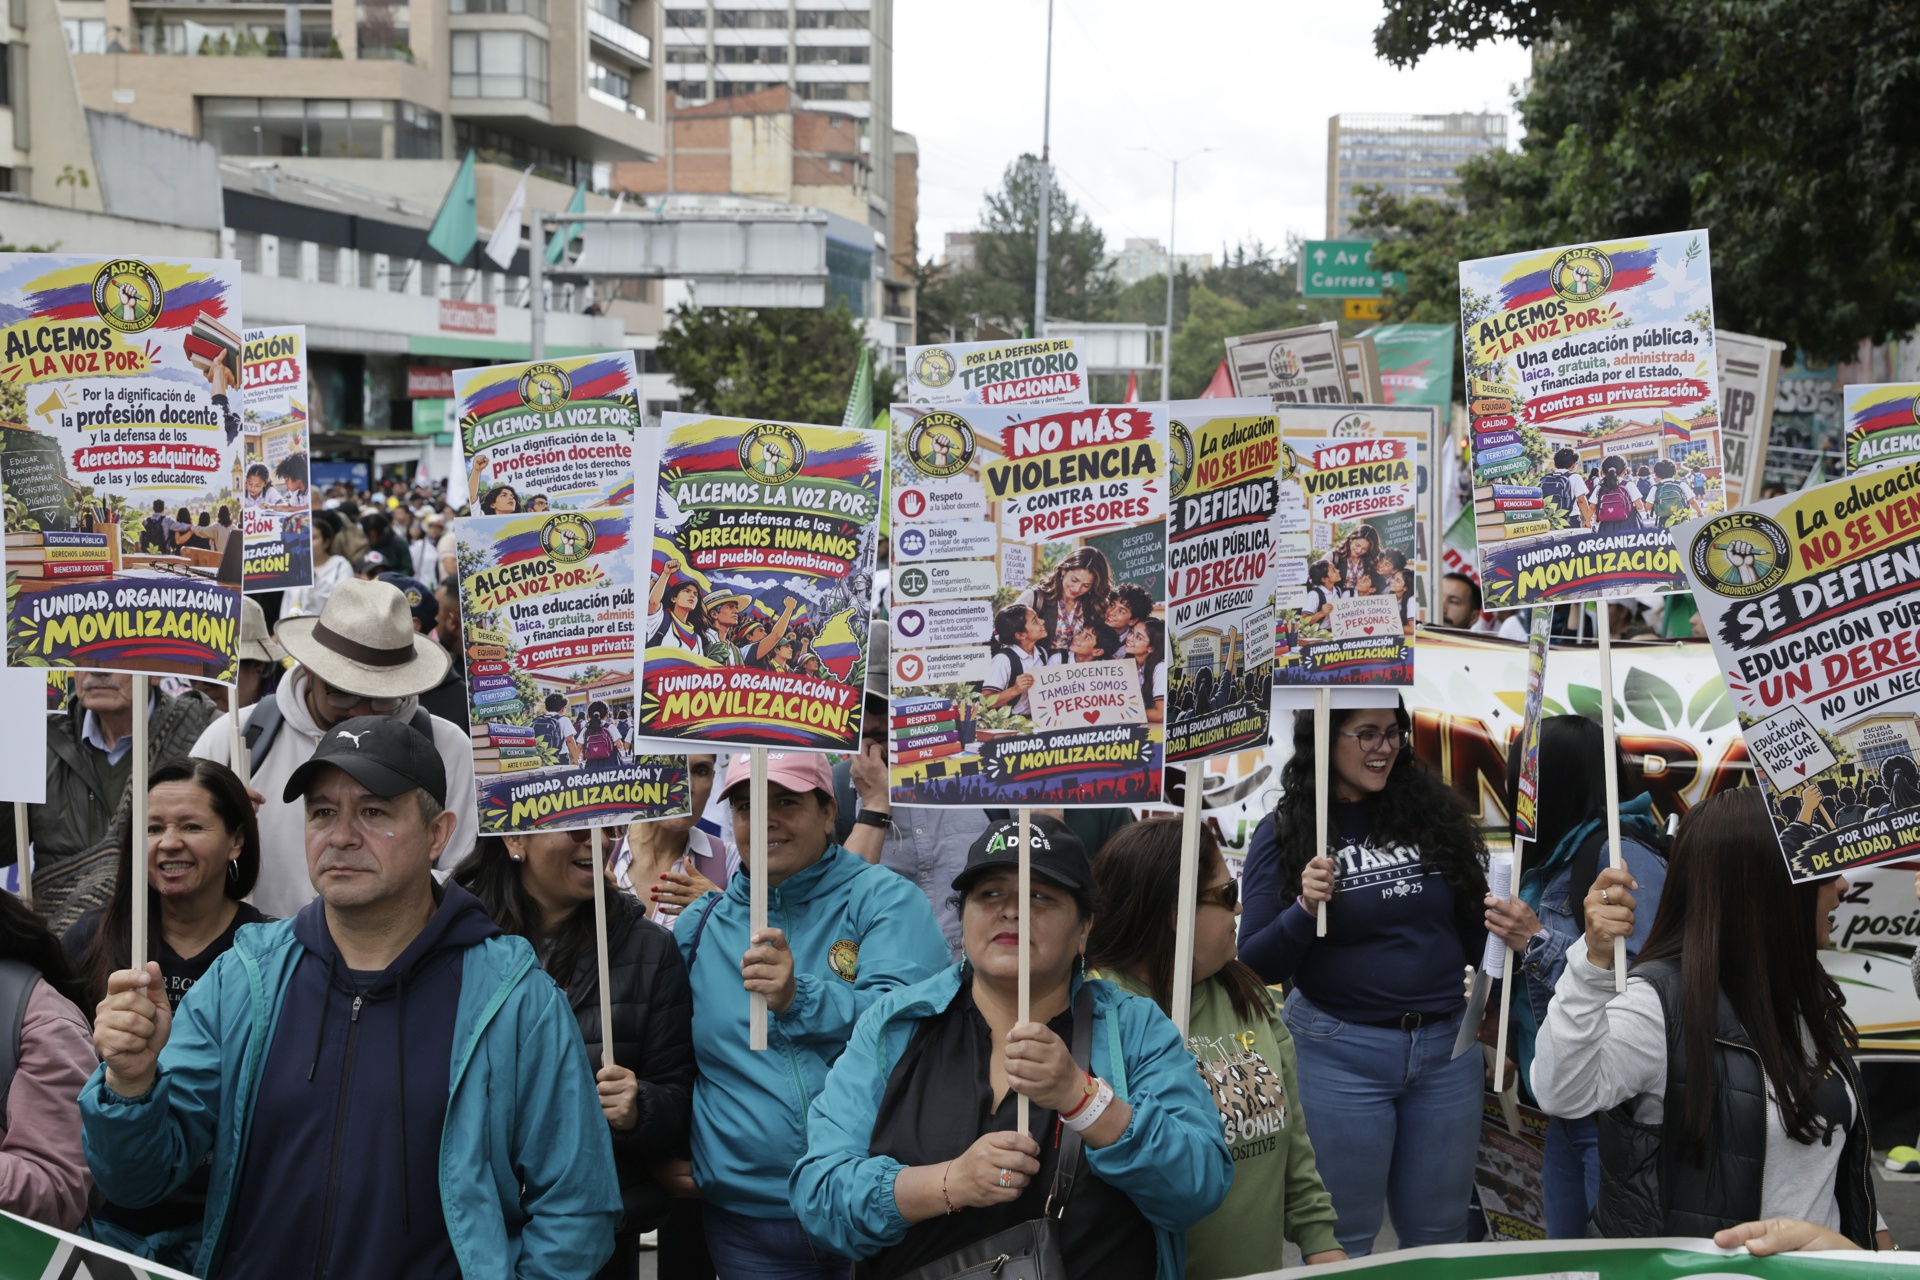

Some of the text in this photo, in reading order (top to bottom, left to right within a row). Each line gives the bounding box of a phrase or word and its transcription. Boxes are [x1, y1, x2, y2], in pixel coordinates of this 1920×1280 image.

[109, 262, 145, 278] ADEC
[1334, 250, 1358, 265] Av
[1563, 248, 1594, 263] ADEC
[1312, 272, 1375, 287] Carrera
[244, 330, 265, 342] UNA
[1479, 300, 1568, 347] ALCEMOS
[1499, 307, 1608, 355] LA VOZ POR:
[4, 327, 112, 362] ALCEMOS
[924, 348, 945, 359] ADEC
[966, 340, 1069, 367] POR LA DEFENSA DEL
[1515, 328, 1700, 370] Una educación pública,
[29, 348, 146, 378] LA VOZ POR:
[959, 352, 1078, 391] TERRITORIO
[1520, 350, 1696, 384] laica, gratuita, administrada
[82, 388, 196, 406] Por la dignificación de
[987, 375, 1078, 405] NACIONAL
[1482, 384, 1511, 398] DERECHO
[1528, 384, 1704, 420] y contra su privatización.
[61, 405, 219, 432] la profesión docente
[925, 411, 959, 428] ADEC
[1480, 402, 1507, 412] EQUIDAD
[472, 407, 635, 447] ALCEMOS LA VOZ POR:
[757, 425, 790, 439] ADEC
[1013, 408, 1134, 457] NO MÁS
[1199, 416, 1275, 460] La educación
[1481, 417, 1509, 430] CALIDAD
[9, 455, 40, 467] EDUCAR
[79, 446, 218, 472] derechos adquiridos
[492, 443, 632, 479] profesión docente
[1196, 435, 1279, 491] NO SE VENDE
[1320, 440, 1394, 470] NO MÁS
[5, 463, 56, 478] TRANSFORMAR
[11, 473, 54, 486] ACOMPAÑAR
[986, 443, 1157, 498] VIOLENCIA
[1304, 461, 1409, 494] VIOLENCIA
[17, 483, 60, 496] CONSTRUIR
[25, 494, 62, 507] DIGNIDAD
[676, 482, 871, 518] ALCEMOS LA VOZ POR:
[929, 491, 963, 503] Respeto
[1026, 481, 1129, 512] CONTRA LOS
[1328, 484, 1392, 503] CONTRA LOS
[1018, 496, 1151, 538] PROFESORES
[1184, 480, 1275, 532] DEFIENDE
[1323, 494, 1405, 519] PROFESORES
[718, 512, 832, 533] La defensa de los
[928, 527, 958, 539] Diálogo
[1709, 514, 1753, 539] ADEC
[1794, 509, 1829, 539] La
[49, 533, 104, 547] EDUCACIÓN PÚBLICA
[51, 548, 107, 560] DERECHOS LABORALES
[689, 526, 857, 562] DERECHOS HUMANOS
[1222, 527, 1270, 558] PÚBLICA
[1799, 513, 1877, 572] NO SE
[53, 562, 106, 576] BIENESTAR DOCENTE
[696, 549, 845, 577] del pueblo colombiano
[931, 566, 950, 577] Cero
[1516, 543, 1576, 573] ¡UNIDAD,
[474, 558, 557, 598] ALCEMOS
[493, 568, 592, 605] LA VOZ POR:
[1184, 552, 1267, 600] DERECHO
[1715, 580, 1766, 597] SUBDIRECTIVA
[32, 587, 233, 623] ¡UNIDAD, ORGANIZACIÓN Y
[928, 605, 987, 617] Reconocimiento
[1735, 594, 1787, 638] SE
[45, 612, 237, 658] MOVILIZACIÓN!
[1737, 616, 1873, 684] EDUCACIÓN
[657, 672, 850, 706] ¡UNIDAD, ORGANIZACIÓN Y
[1038, 679, 1129, 700] TAMBIÉN SOMOS
[1040, 665, 1125, 687] LOS DOCENTES
[1758, 664, 1813, 707] UN
[661, 691, 851, 733] MOVILIZACION!
[905, 699, 944, 714] EDUCACIÓN
[905, 713, 937, 726] RESPETO
[1052, 692, 1127, 717] PERSONAS
[907, 734, 949, 749] CONVIVENCIA
[909, 723, 940, 736] DIÁLOGO
[995, 725, 1132, 759] ¡UNIDAD, ORGANIZACIÓN
[1752, 717, 1807, 753] EDUCACIÓN
[1764, 720, 1779, 734] LA
[918, 748, 934, 758] PAZ
[1004, 739, 1141, 774] Y MOVILIZACIÓN!
[1762, 731, 1813, 763] PÚBLICA
[1769, 741, 1821, 774] NOS UNE
[510, 765, 664, 802] ¡UNIDAD, ORGANIZACIÓN Y
[510, 781, 670, 820] MOVILIZACIÓN!
[987, 833, 1043, 856] ADC
[1242, 1105, 1285, 1141] ONLY
